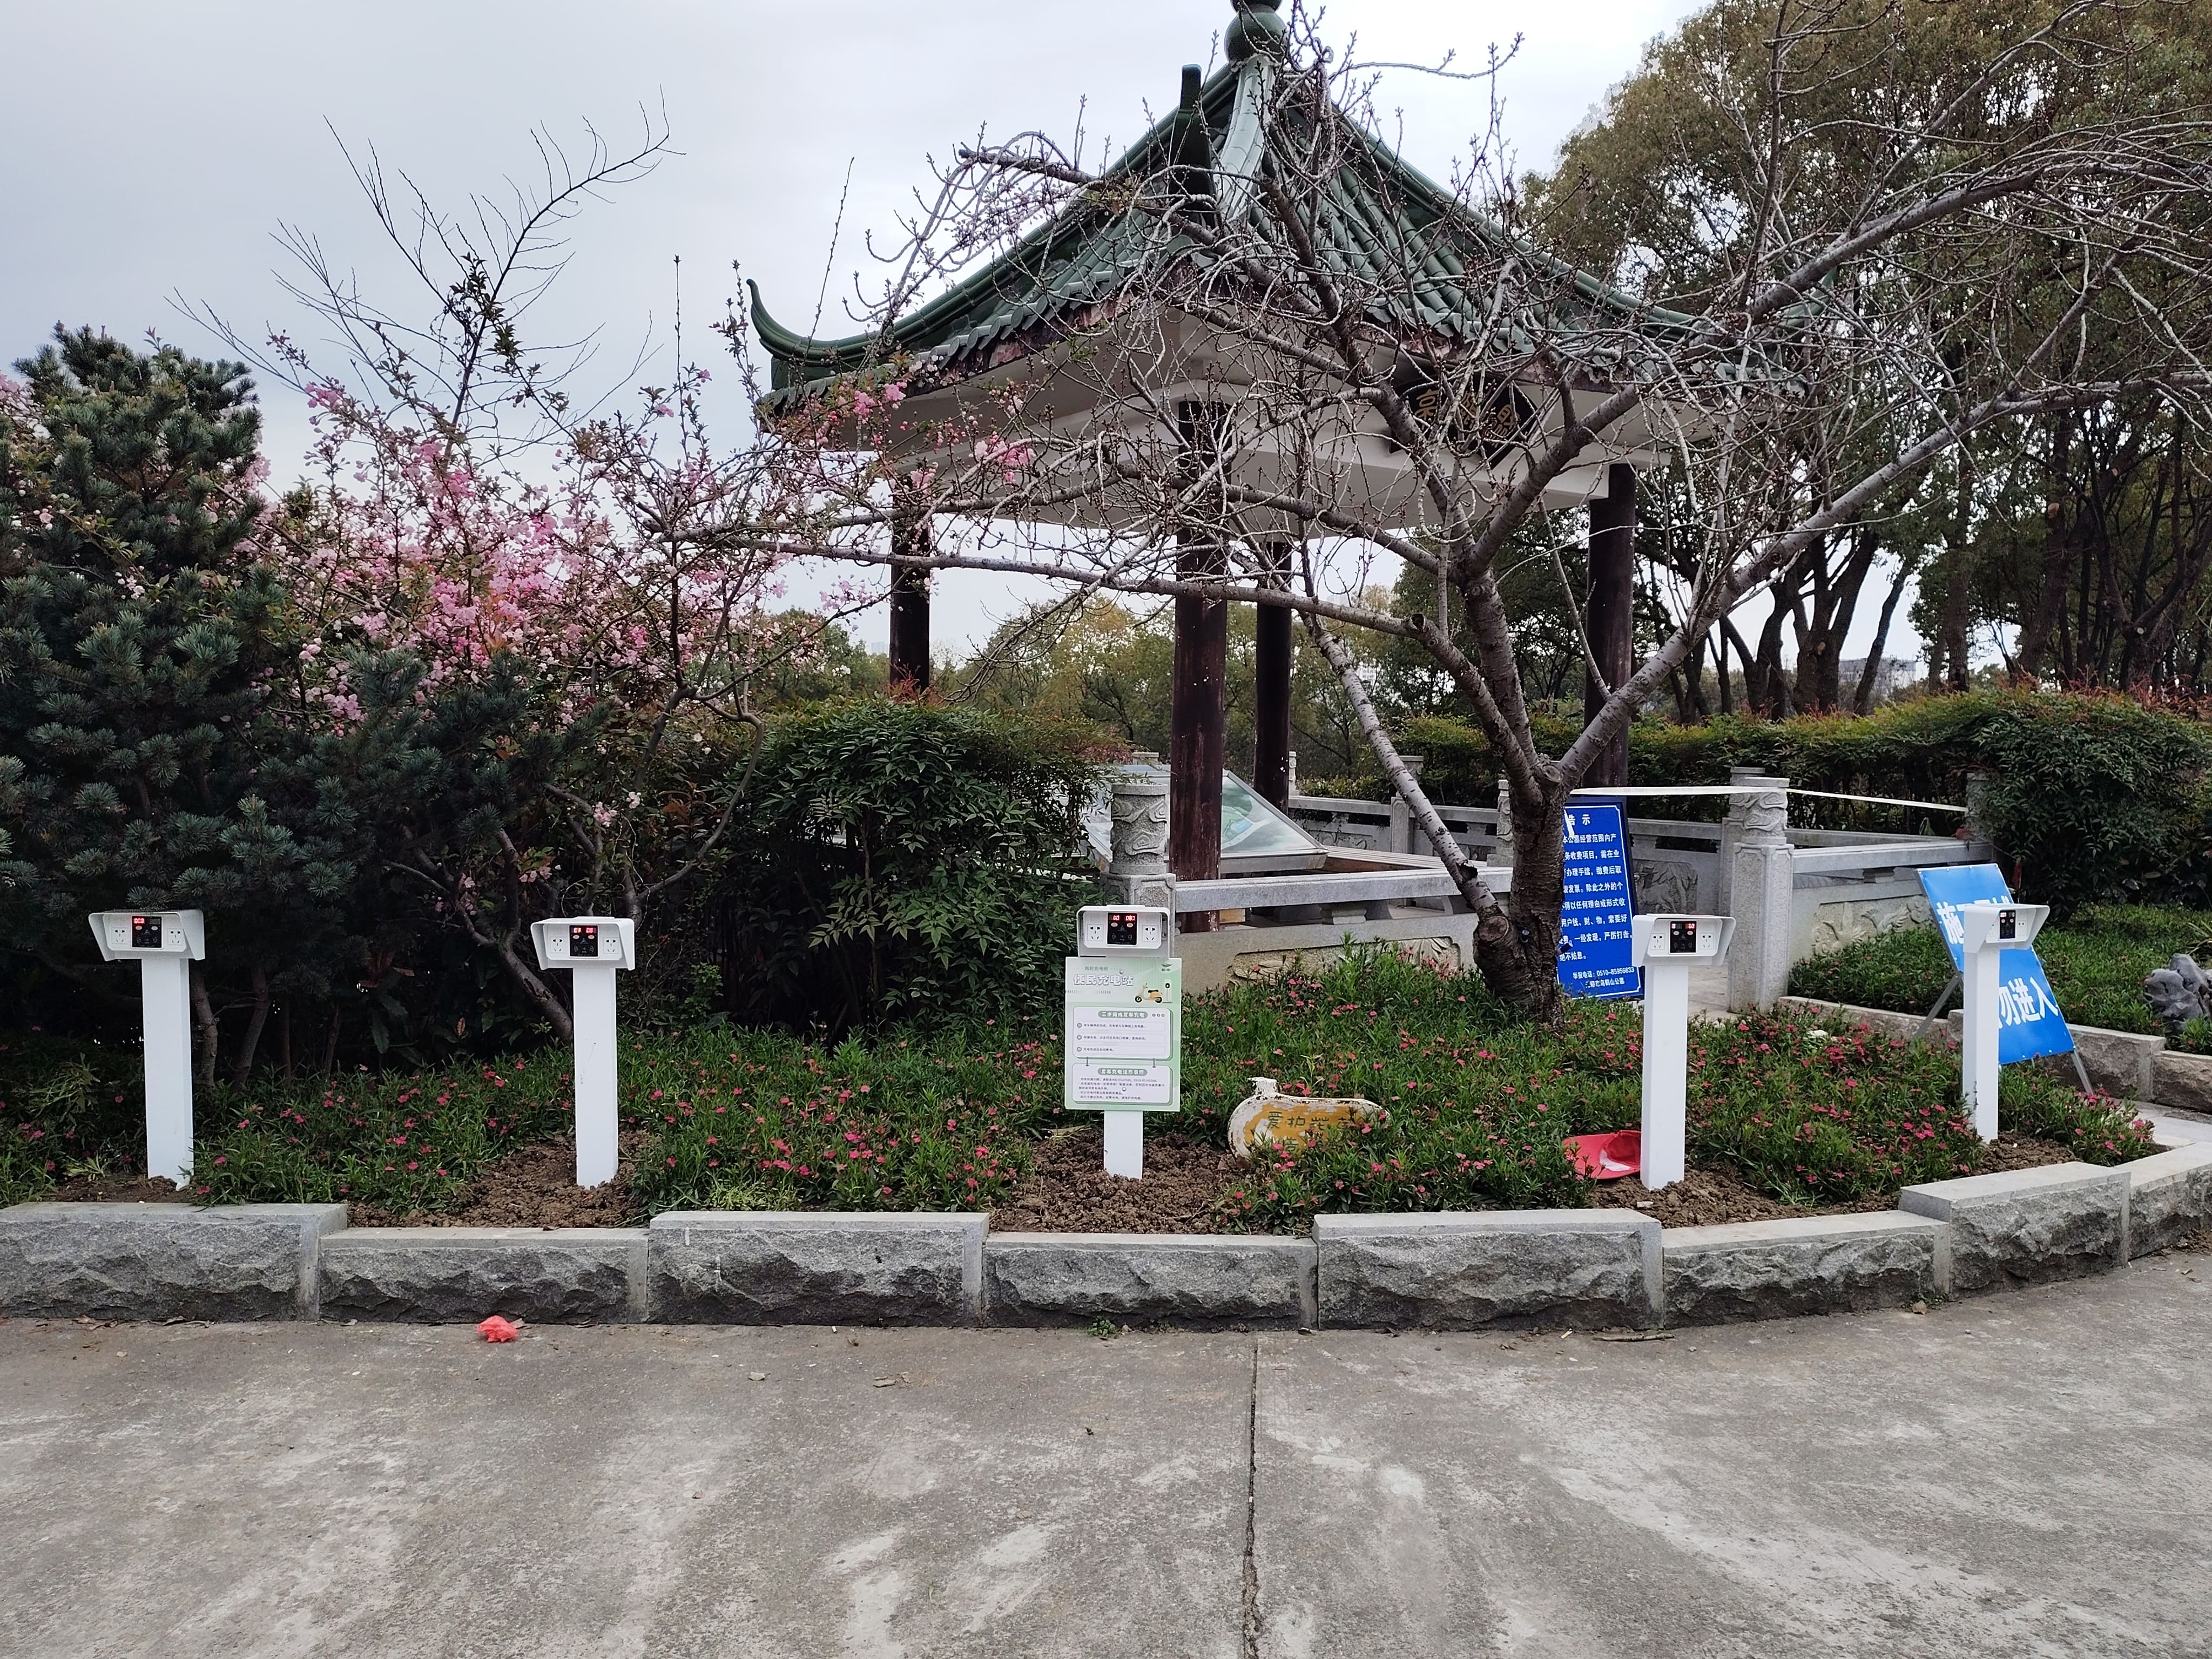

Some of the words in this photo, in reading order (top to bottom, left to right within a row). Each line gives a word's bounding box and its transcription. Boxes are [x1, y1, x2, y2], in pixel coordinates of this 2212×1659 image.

[1564, 865, 1622, 877] 办理手续，缴费后取
[1073, 974, 1134, 987] 便民充电站
[1998, 976, 2058, 1029] 勿进入
